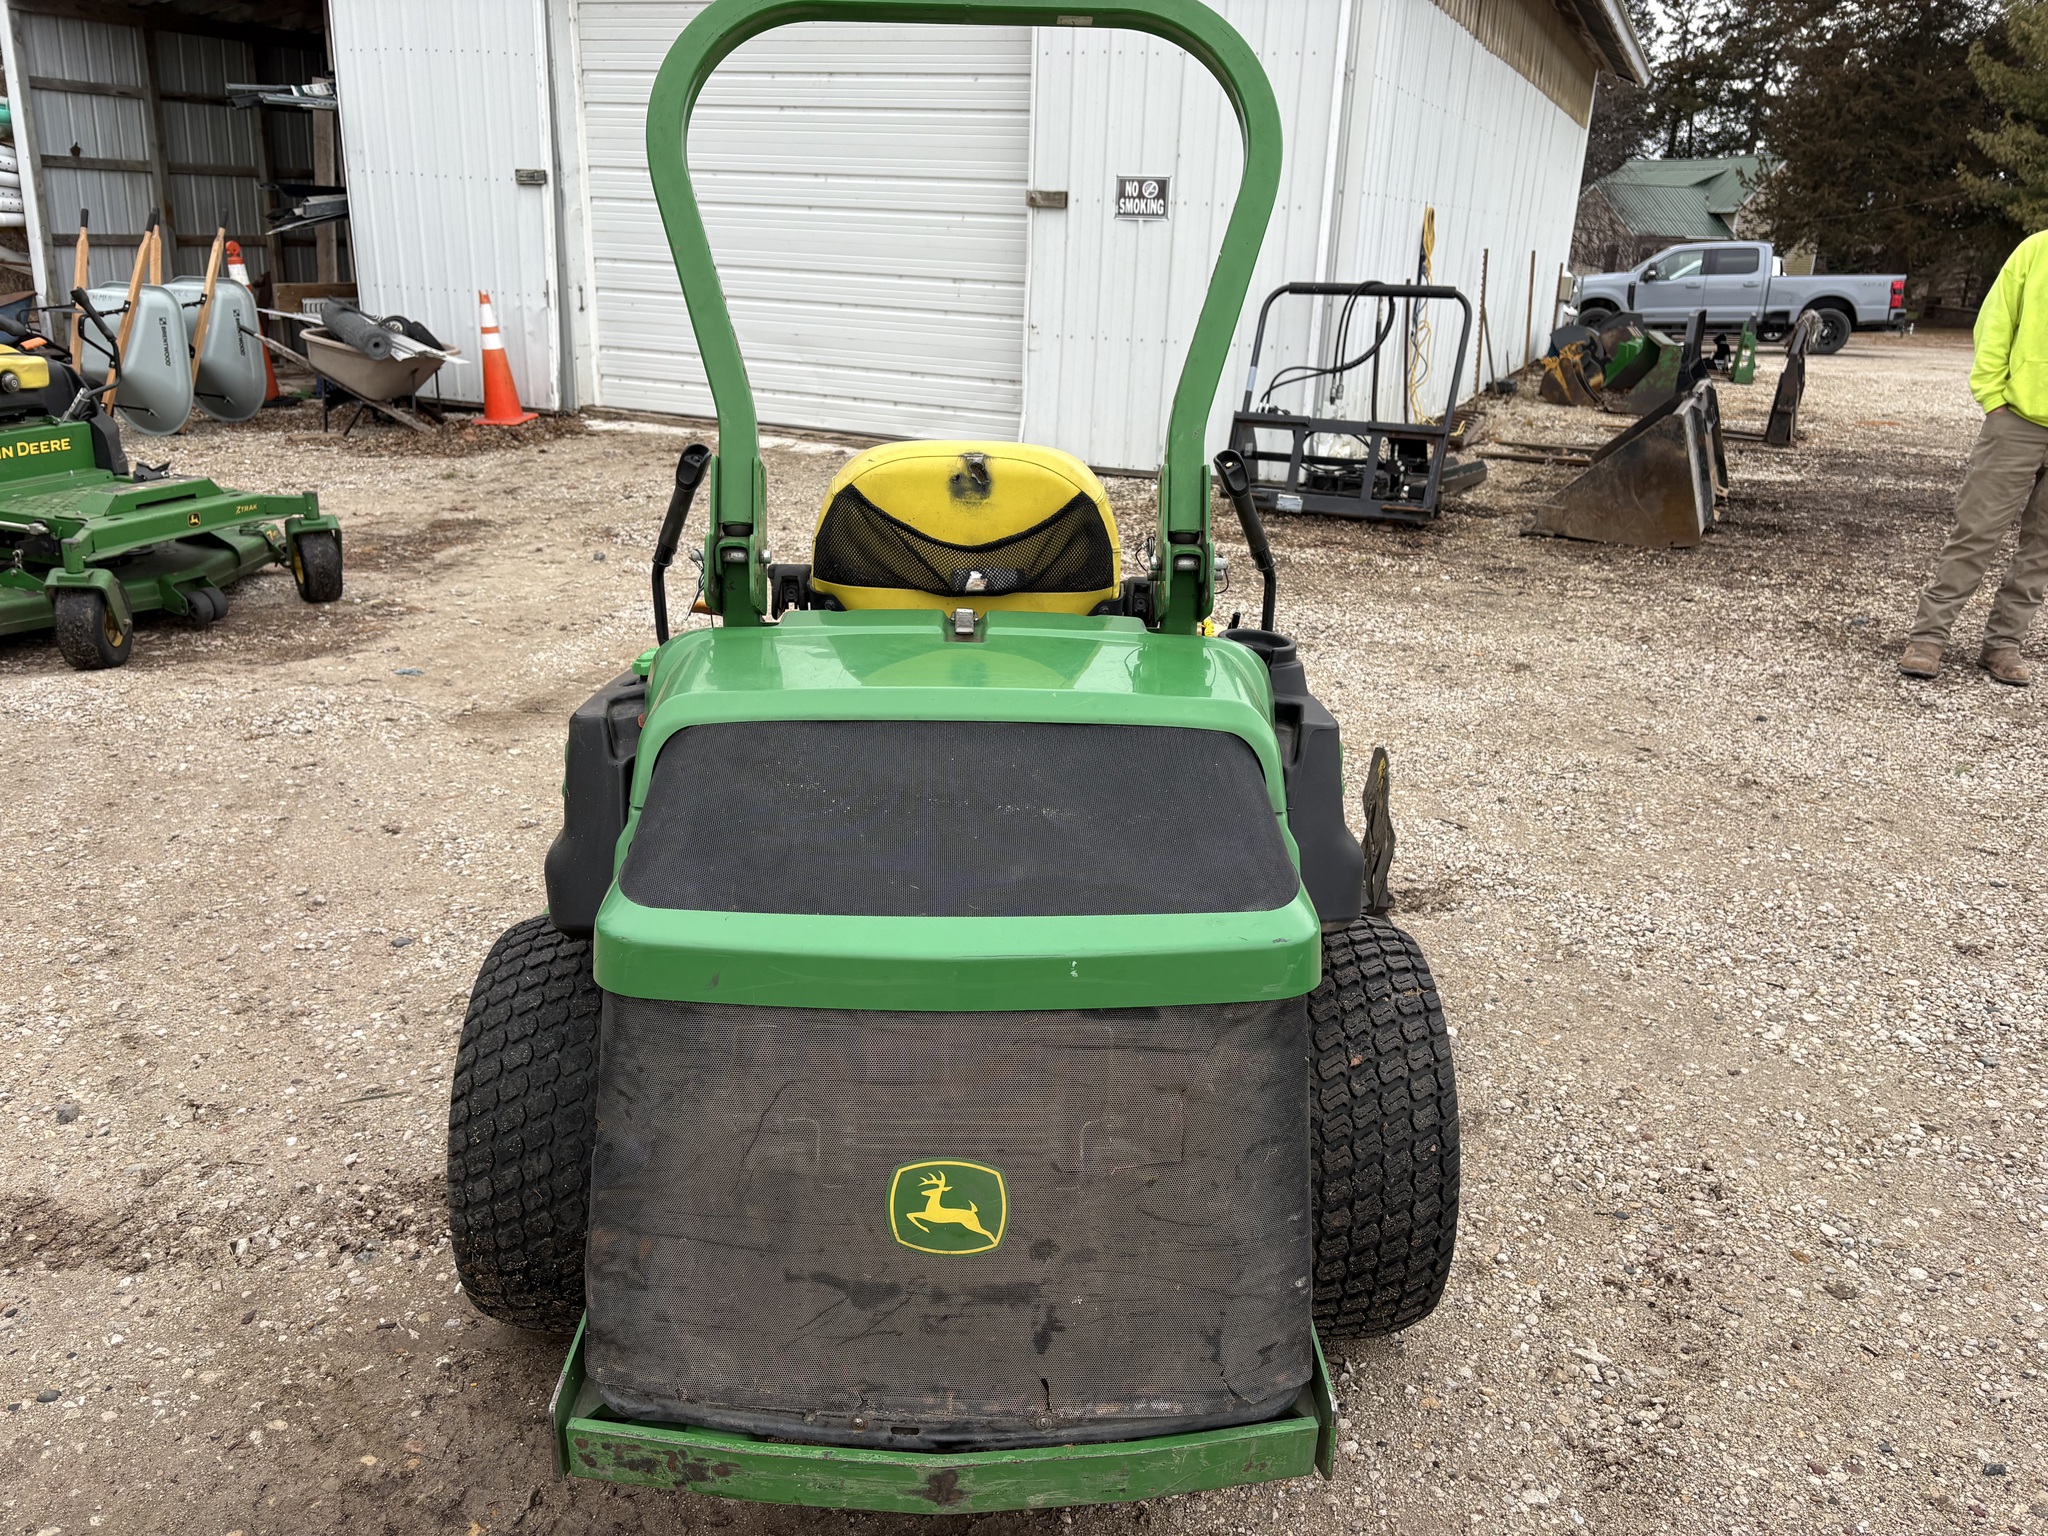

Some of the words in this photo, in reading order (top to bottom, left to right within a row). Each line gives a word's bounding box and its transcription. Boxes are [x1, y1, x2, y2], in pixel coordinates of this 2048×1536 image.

[1125, 180, 1139, 197] NO
[1119, 198, 1165, 215] SMOKING
[161, 326, 171, 367] BRENTWOOD
[16, 438, 71, 457] DEERE
[235, 503, 258, 515] ZTRAK
